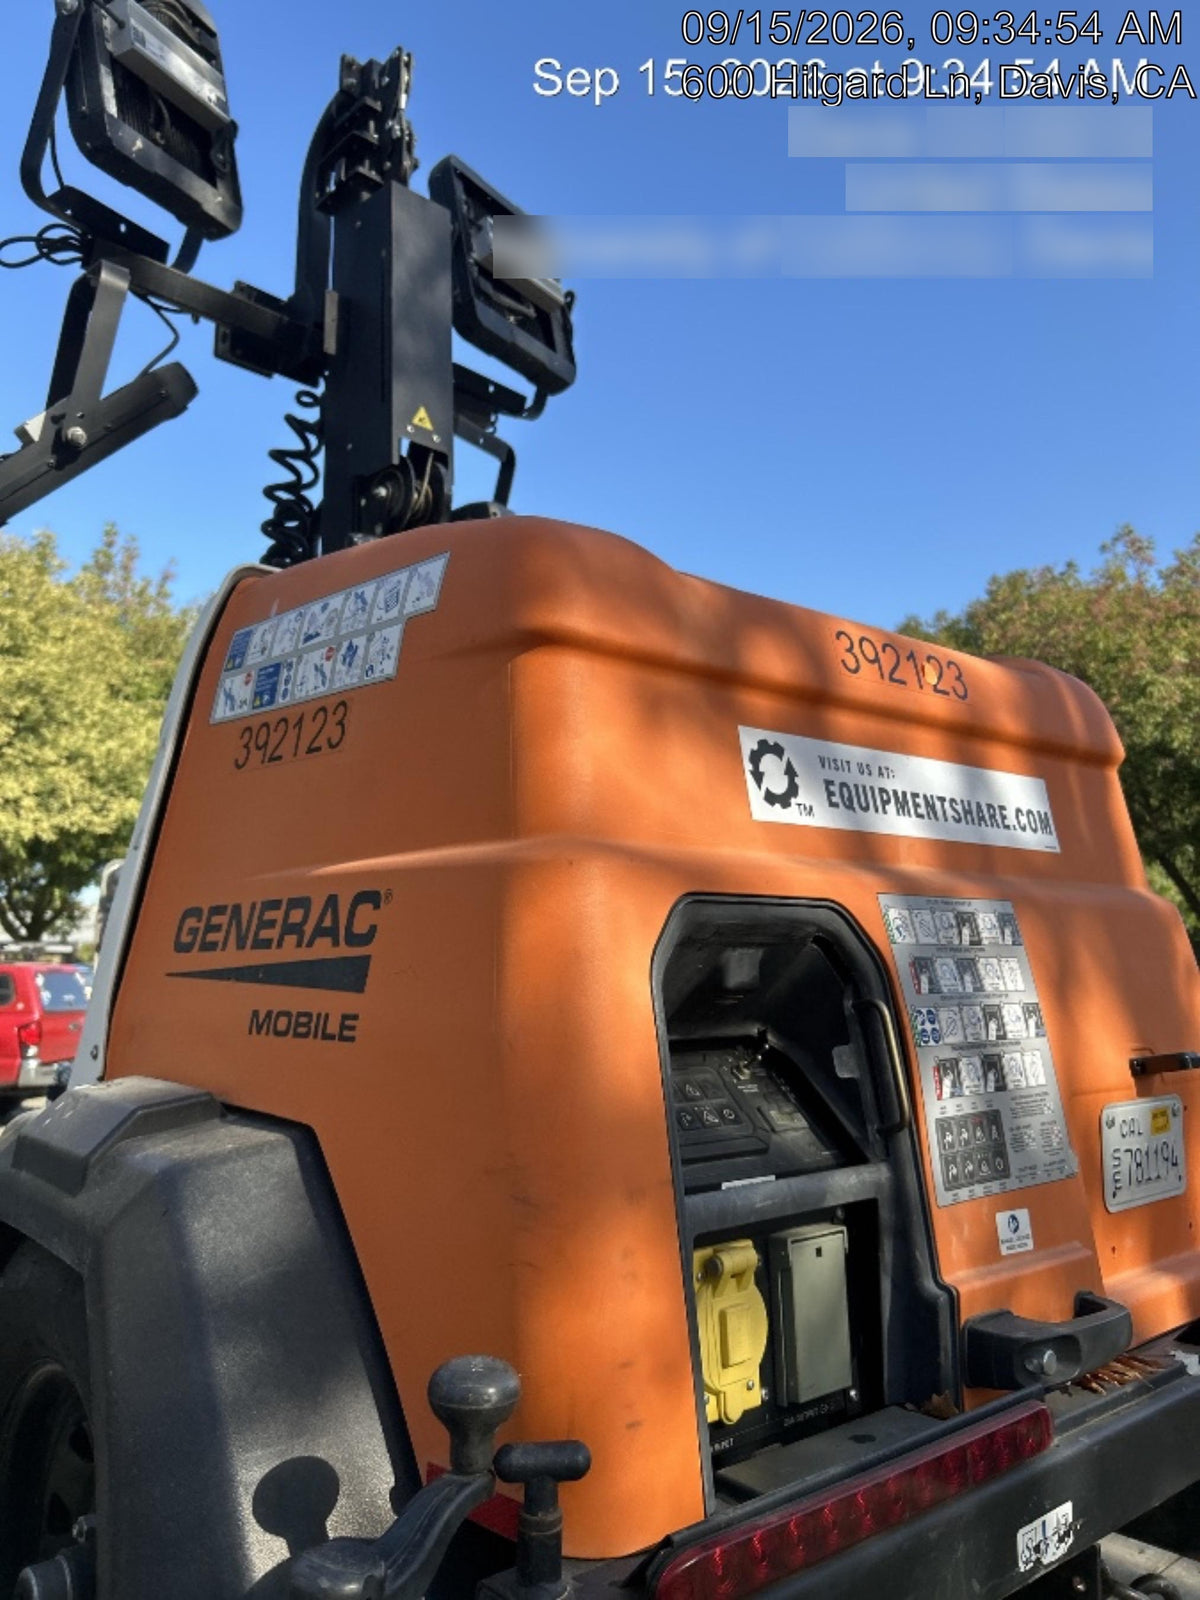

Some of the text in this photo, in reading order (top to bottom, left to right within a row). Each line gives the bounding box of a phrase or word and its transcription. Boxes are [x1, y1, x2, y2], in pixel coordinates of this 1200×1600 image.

[836, 630, 969, 700] 392123
[234, 700, 348, 770] 392123
[817, 755, 896, 779] VISIT US AT:
[823, 778, 1054, 837] EQUIPMENTSHARE.COM
[173, 889, 383, 954] GENERAC
[247, 1009, 360, 1043] MOBILE
[1119, 1117, 1144, 1138] CAL
[1123, 1141, 1179, 1187] 781194
